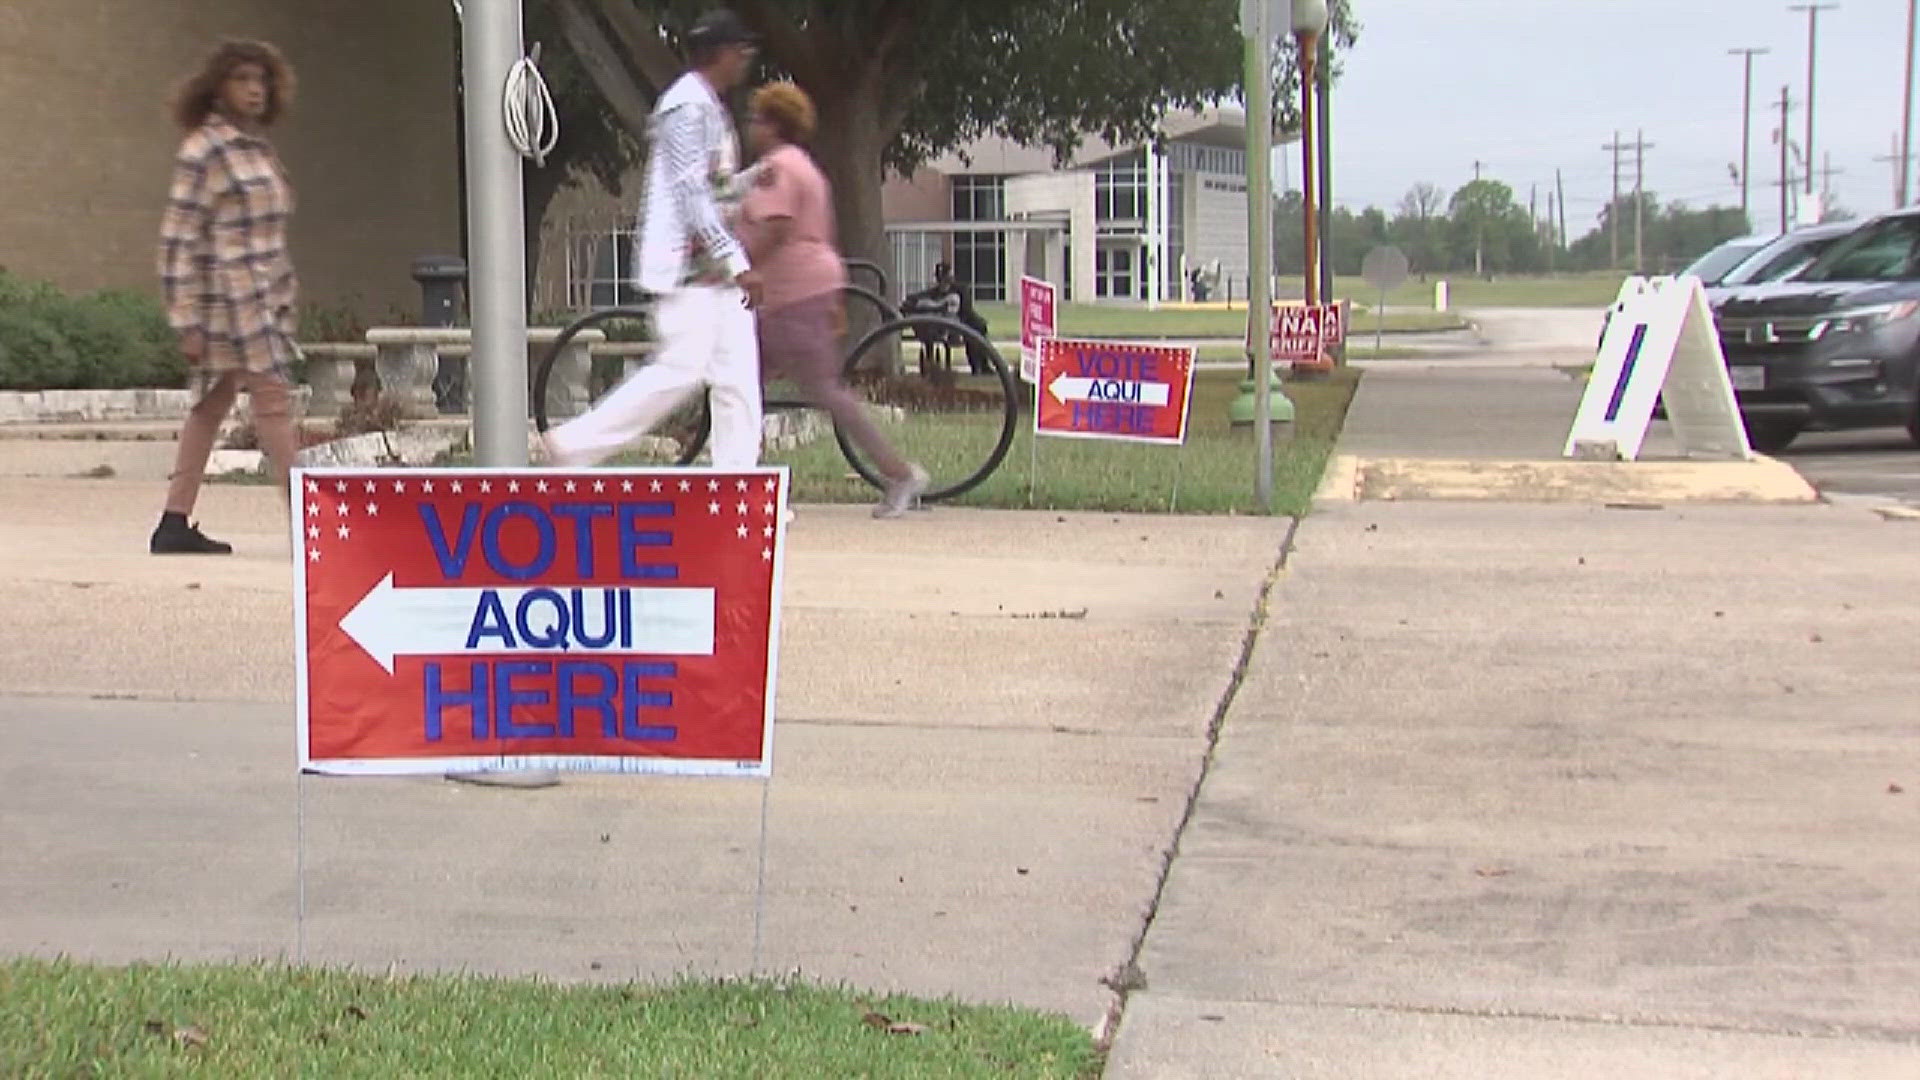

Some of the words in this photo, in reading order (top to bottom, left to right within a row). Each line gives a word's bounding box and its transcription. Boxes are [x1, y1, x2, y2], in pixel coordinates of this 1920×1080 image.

[1077, 350, 1159, 381] VOTE
[1088, 379, 1142, 403] AQUI
[1072, 400, 1155, 433] HERE
[417, 501, 679, 581] VOTE
[465, 587, 633, 653] AQUI
[424, 661, 678, 742] HERE
